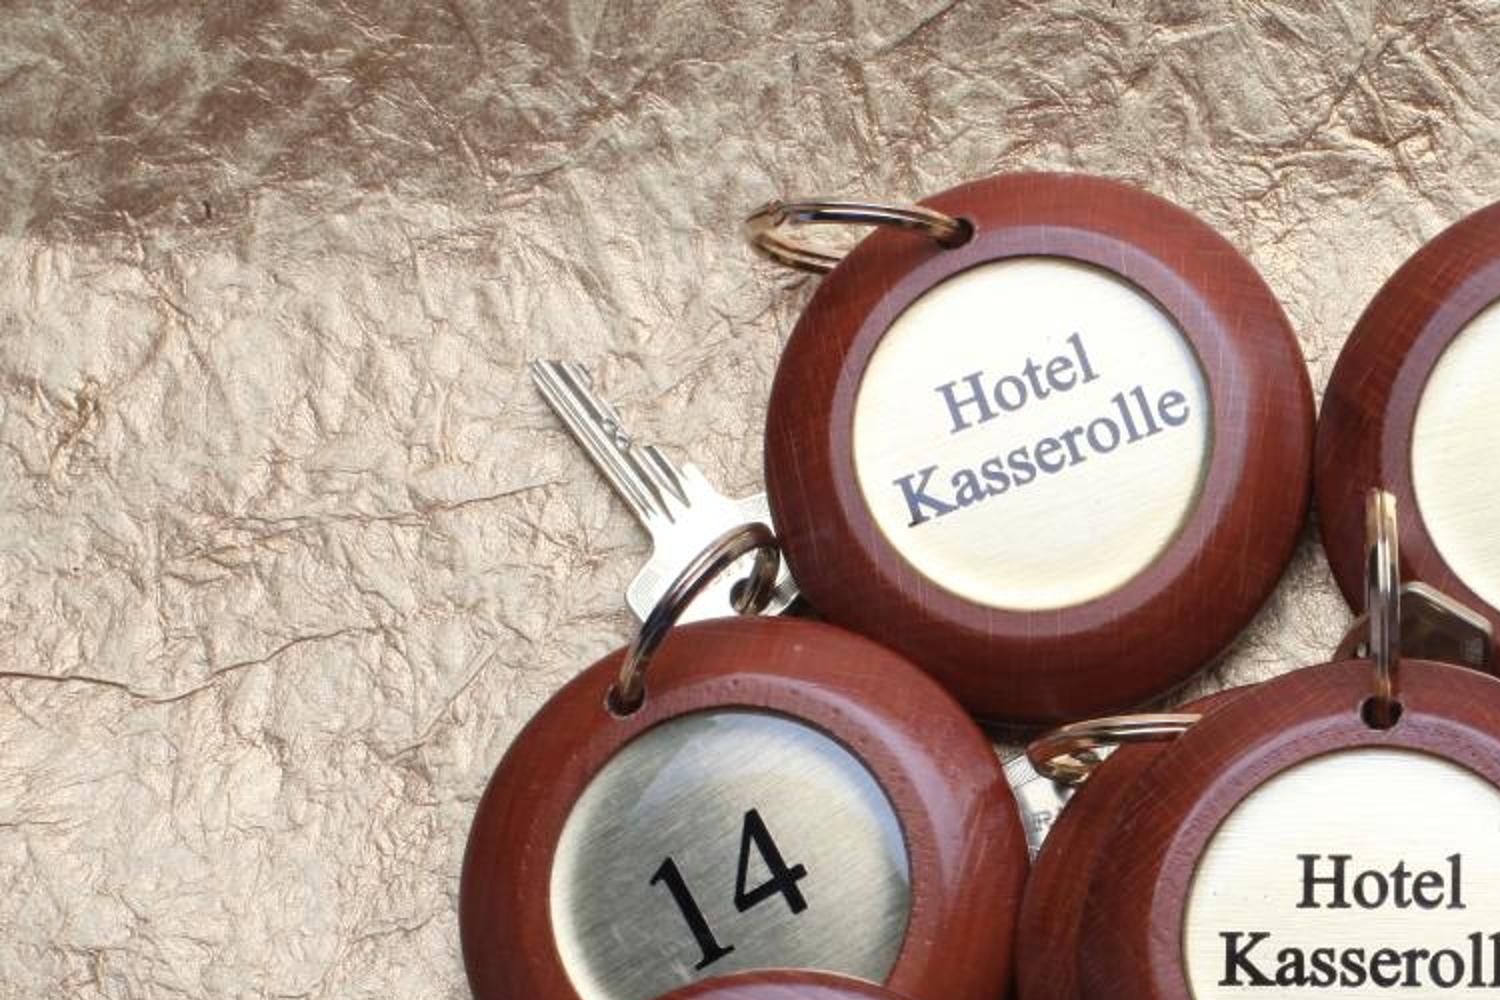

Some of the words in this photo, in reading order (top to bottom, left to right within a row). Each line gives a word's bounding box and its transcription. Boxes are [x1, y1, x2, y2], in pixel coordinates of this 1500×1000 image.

[935, 332, 1099, 435] Hotel
[893, 386, 1191, 529] Kasserolle
[649, 808, 809, 975] 14
[1295, 853, 1467, 910] Hotel
